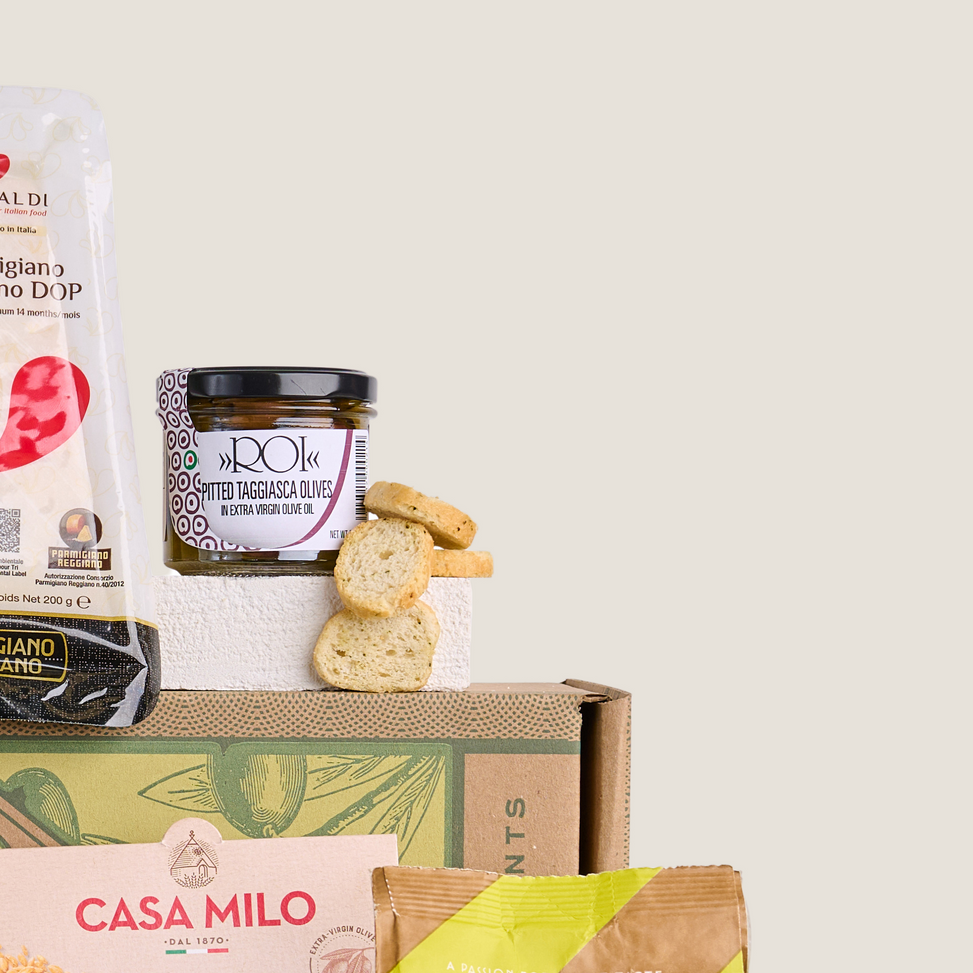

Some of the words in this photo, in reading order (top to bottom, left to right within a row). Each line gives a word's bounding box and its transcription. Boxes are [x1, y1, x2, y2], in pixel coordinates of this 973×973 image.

[4, 207, 27, 216] italian
[29, 208, 48, 216] food
[31, 281, 82, 300] DOP
[202, 482, 234, 501] PITTED
[237, 480, 298, 500] TAGGIASCA
[300, 480, 332, 499] OLIVES
[221, 505, 228, 516] IN
[230, 504, 254, 515] EXTRA
[256, 504, 280, 515] VIRGIN
[282, 504, 303, 514] OLIVE
[304, 503, 314, 514] OIL
[52, 550, 109, 560] PARMIGIANO
[58, 558, 103, 569] REGGIANO
[23, 594, 41, 603] Net
[44, 595, 62, 605] 200
[66, 597, 72, 607] g
[76, 897, 194, 932] CASA
[205, 891, 316, 928] MILO
[310, 926, 354, 955] EXTRA-VIRGIN
[446, 961, 455, 971] A
